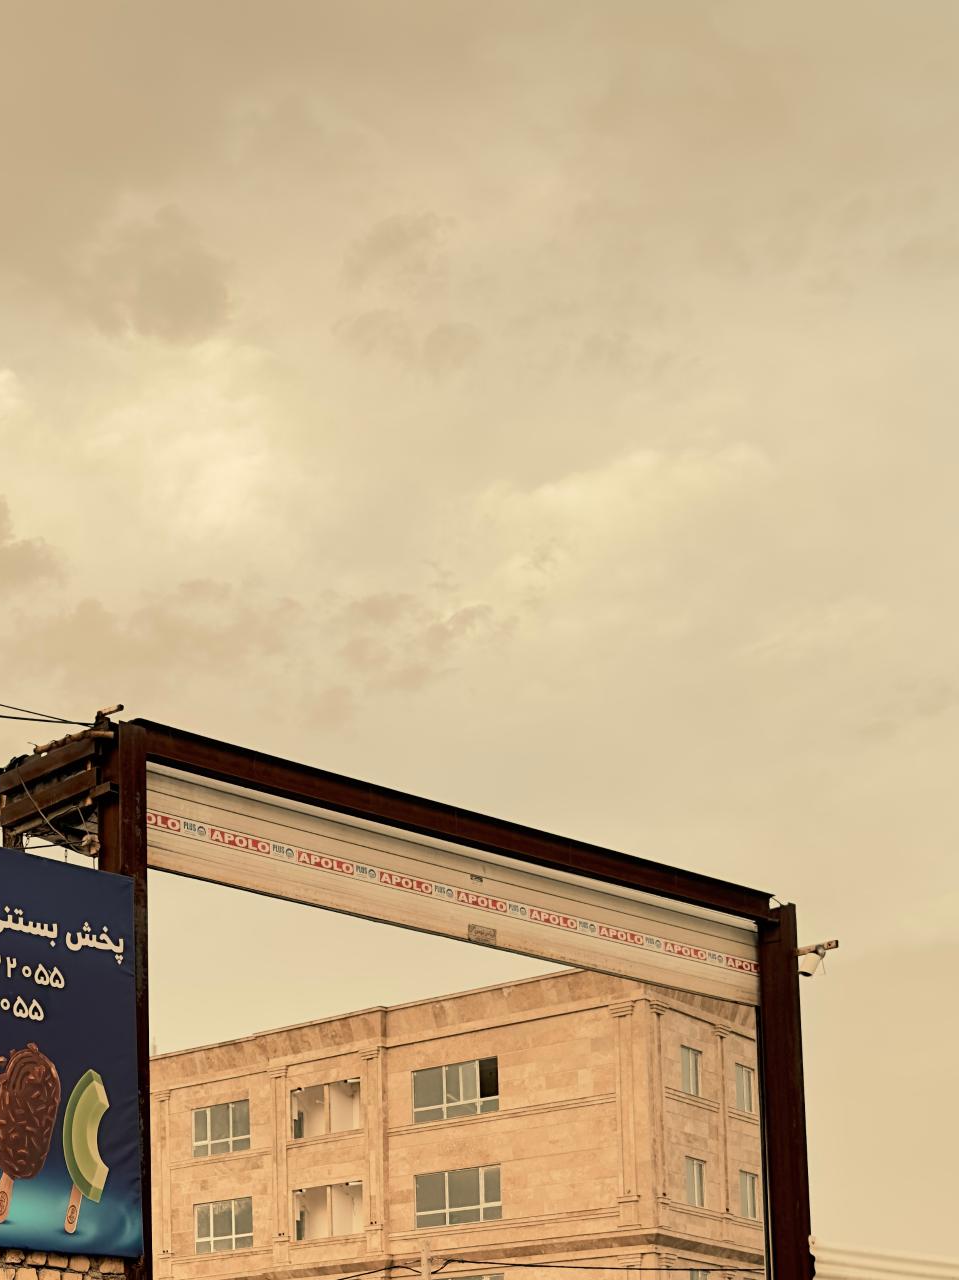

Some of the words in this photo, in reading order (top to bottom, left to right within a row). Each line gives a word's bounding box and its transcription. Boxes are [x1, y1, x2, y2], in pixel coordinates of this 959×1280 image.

[65, 921, 125, 965] پخش
[147, 812, 180, 831] OLO
[183, 821, 196, 832] PLUS
[211, 830, 270, 853] APOLO
[272, 844, 285, 854] PLUS
[299, 852, 354, 874] APOLO
[355, 864, 368, 875] PLUS
[380, 872, 432, 894] APOLO
[434, 884, 446, 894] PLUS
[458, 891, 507, 912] APOLO
[530, 910, 577, 929] APOLO
[599, 927, 643, 945] APOLO
[665, 943, 706, 960] APOLO
[726, 957, 760, 972] APOL
